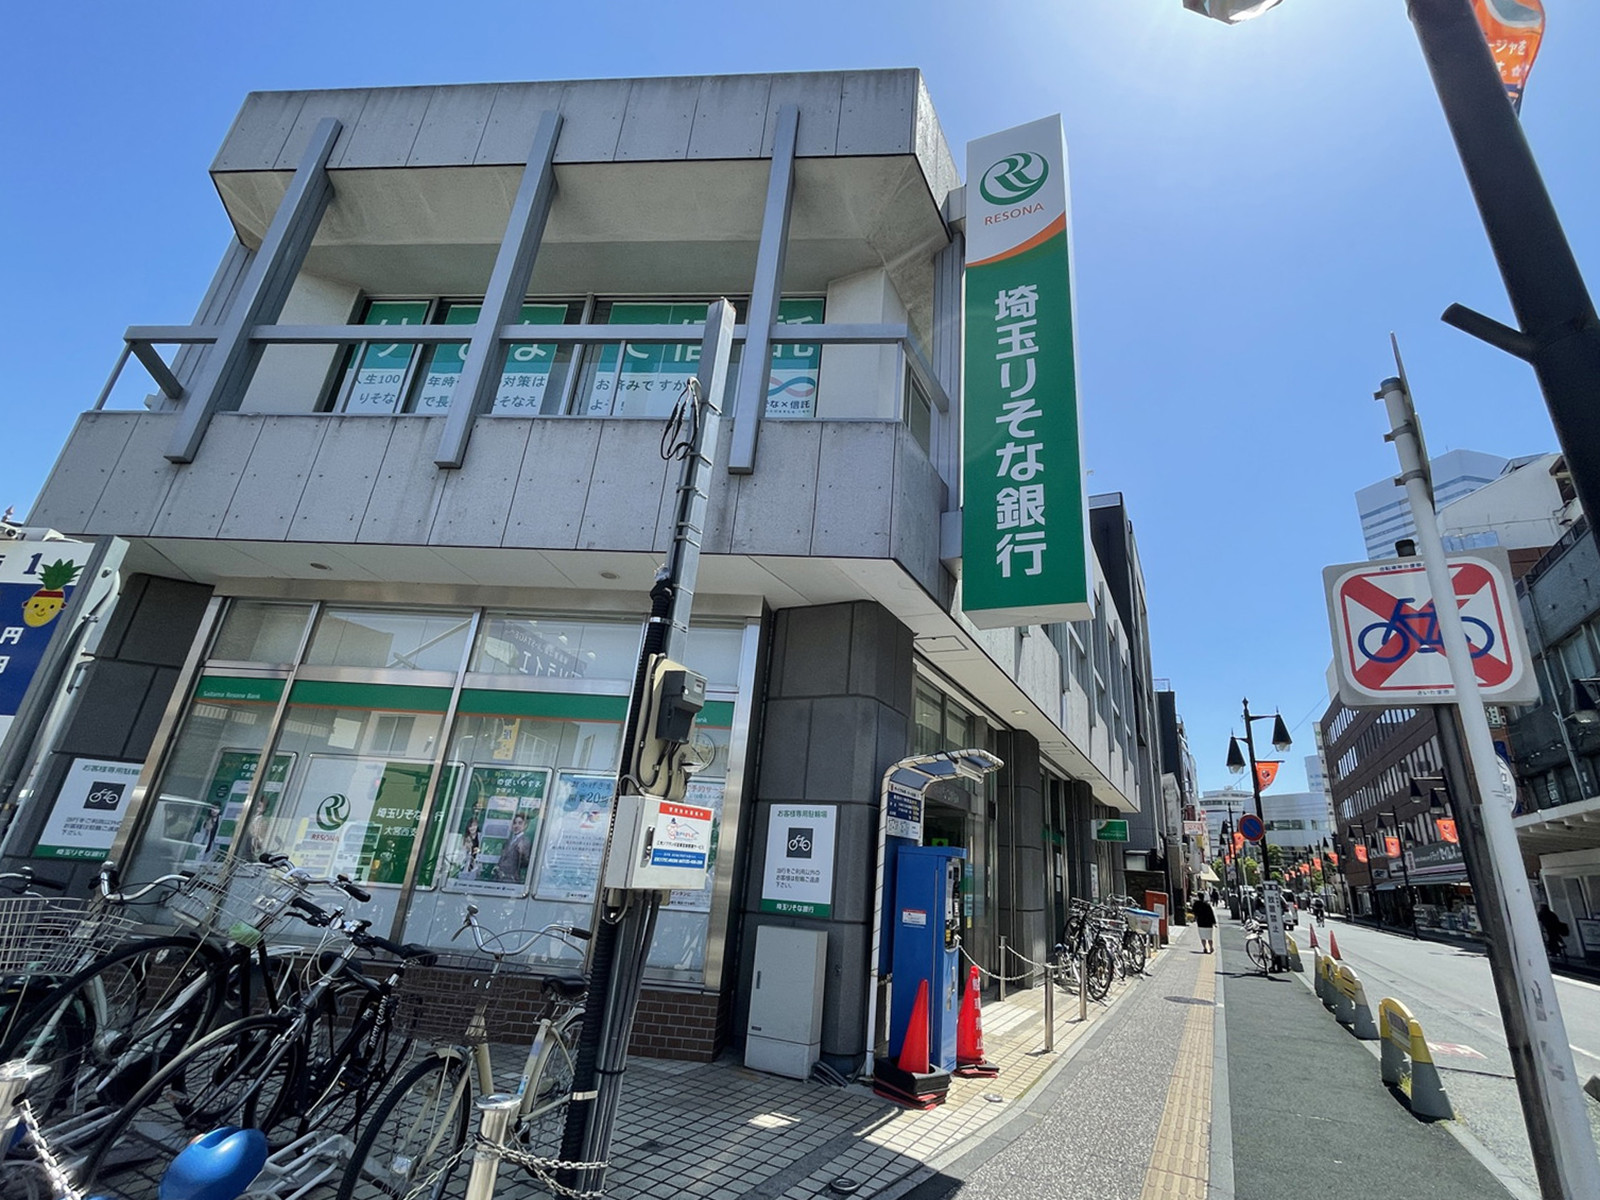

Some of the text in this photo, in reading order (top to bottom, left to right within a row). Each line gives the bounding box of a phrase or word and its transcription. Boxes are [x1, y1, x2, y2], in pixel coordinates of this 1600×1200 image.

[984, 202, 1044, 226] RESONA
[995, 283, 1047, 578] 埼玉りそな銀行
